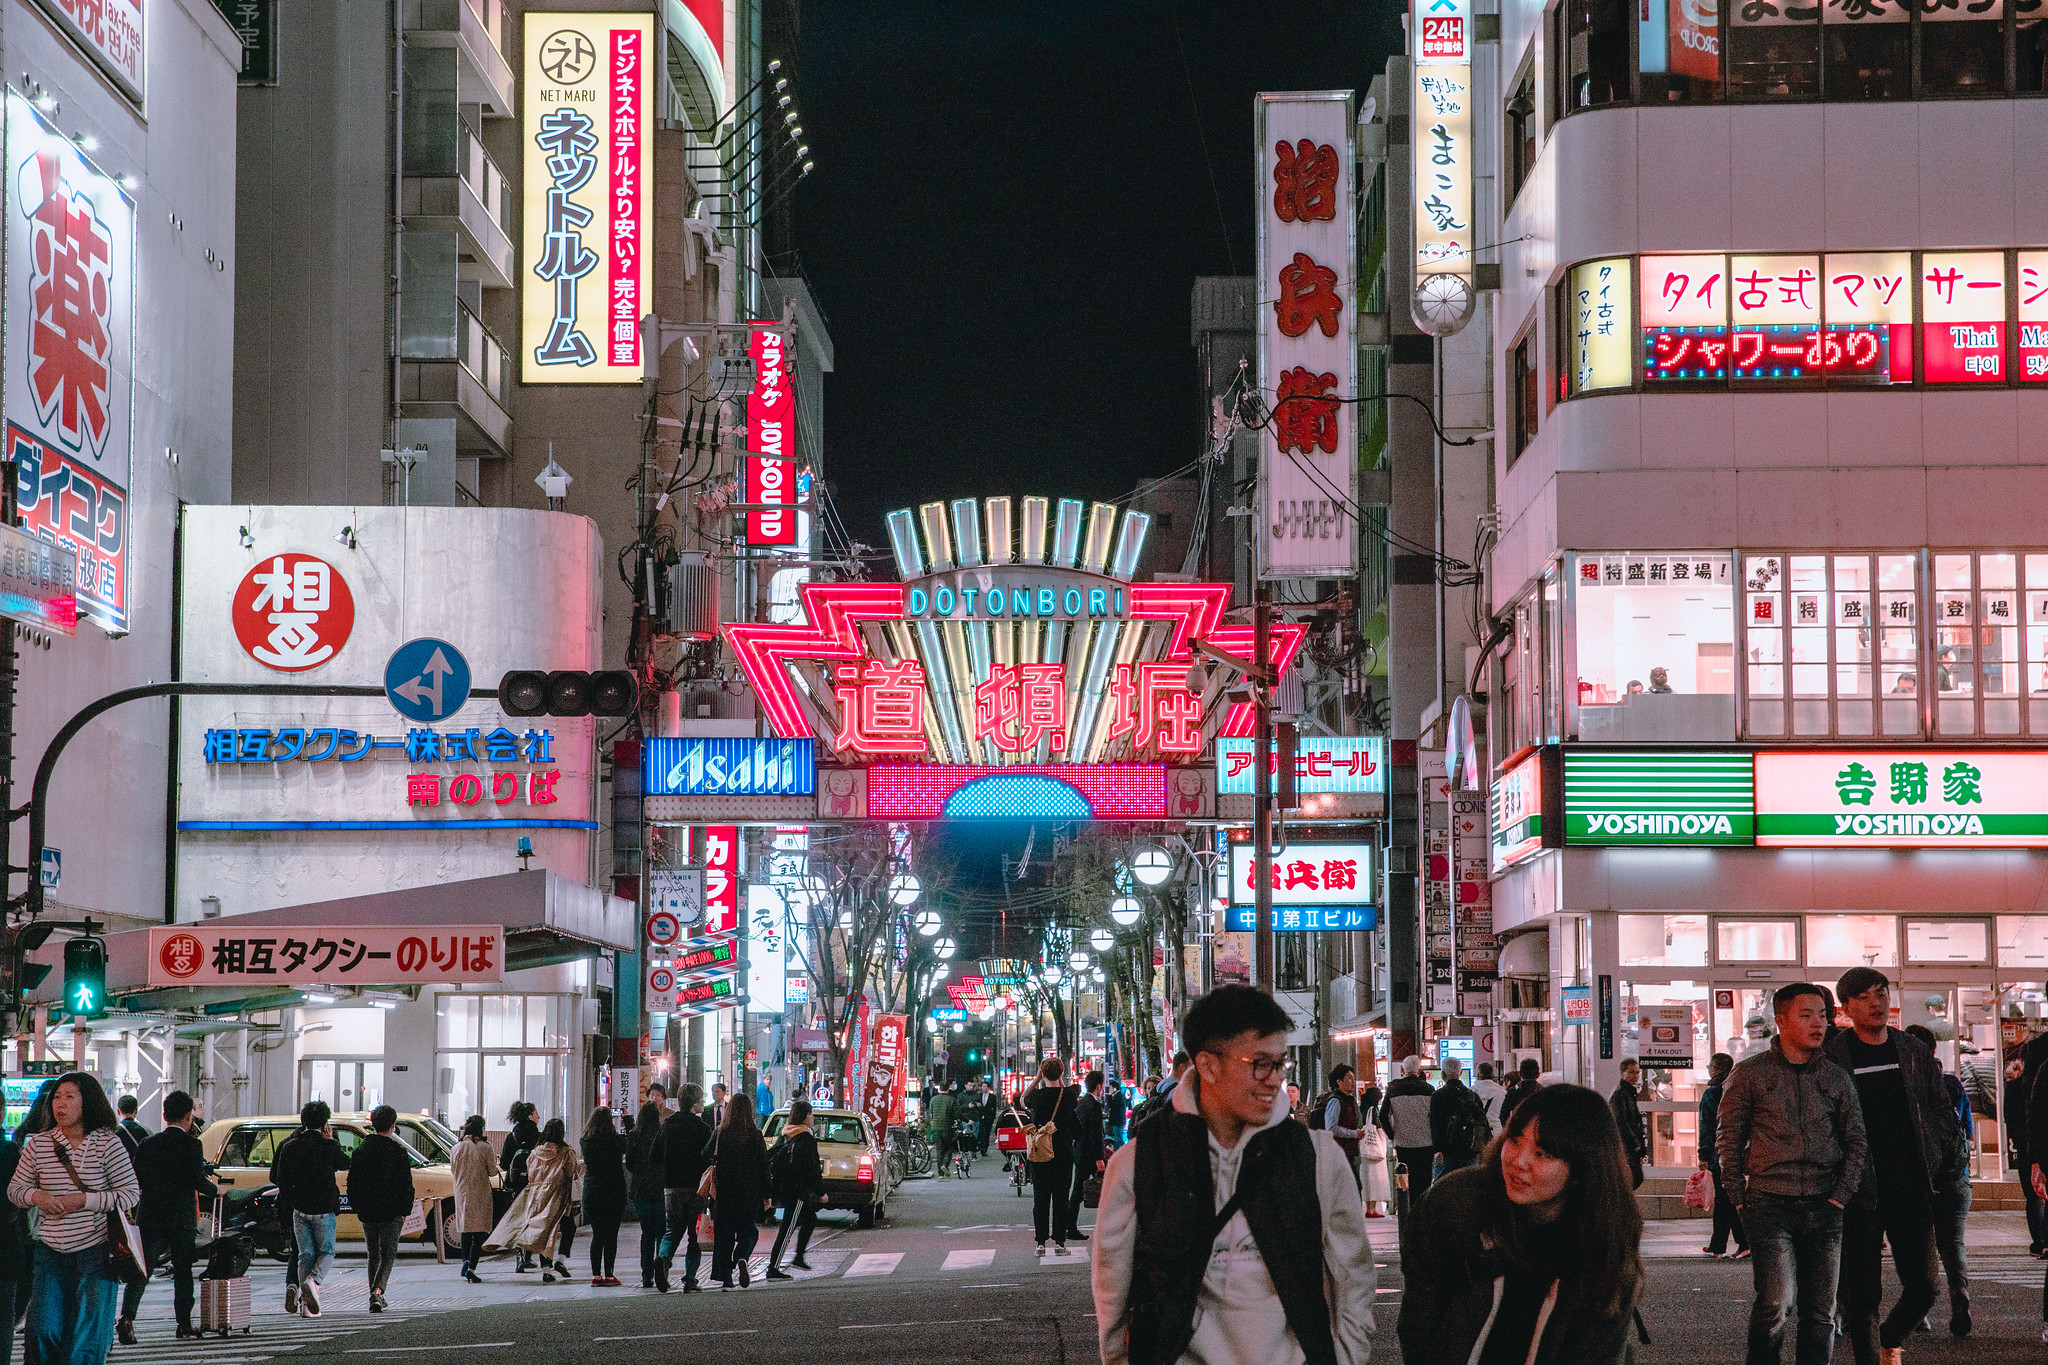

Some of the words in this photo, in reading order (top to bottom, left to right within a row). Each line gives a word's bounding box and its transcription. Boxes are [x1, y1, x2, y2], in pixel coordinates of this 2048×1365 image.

[1424, 41, 1462, 53] 年中無休
[1425, 20, 1462, 40] 24H
[108, 24, 136, 80] 면세
[540, 90, 561, 101] NET
[564, 90, 595, 101] MARU
[534, 108, 599, 366] ネットルーム
[1597, 266, 1615, 337] タイ古式
[613, 278, 635, 363] 完全個室
[1577, 289, 1594, 387] マッサージ
[1951, 328, 1997, 347] Thai
[1656, 331, 1878, 367] シャワーあり
[1966, 357, 1998, 374] 타이
[761, 331, 783, 407] カラオケ
[9, 436, 124, 556] ダイコク
[910, 588, 1122, 616] DOTONBORI
[835, 657, 1201, 753] 道頓堀
[203, 727, 556, 764] 相互タクシー株式会社
[667, 741, 794, 791] Asahi
[407, 769, 561, 807] 南のりば
[1586, 814, 1733, 835] YOSHINOYA
[1834, 814, 1984, 835] YOSHINOYA
[655, 975, 669, 986] 30
